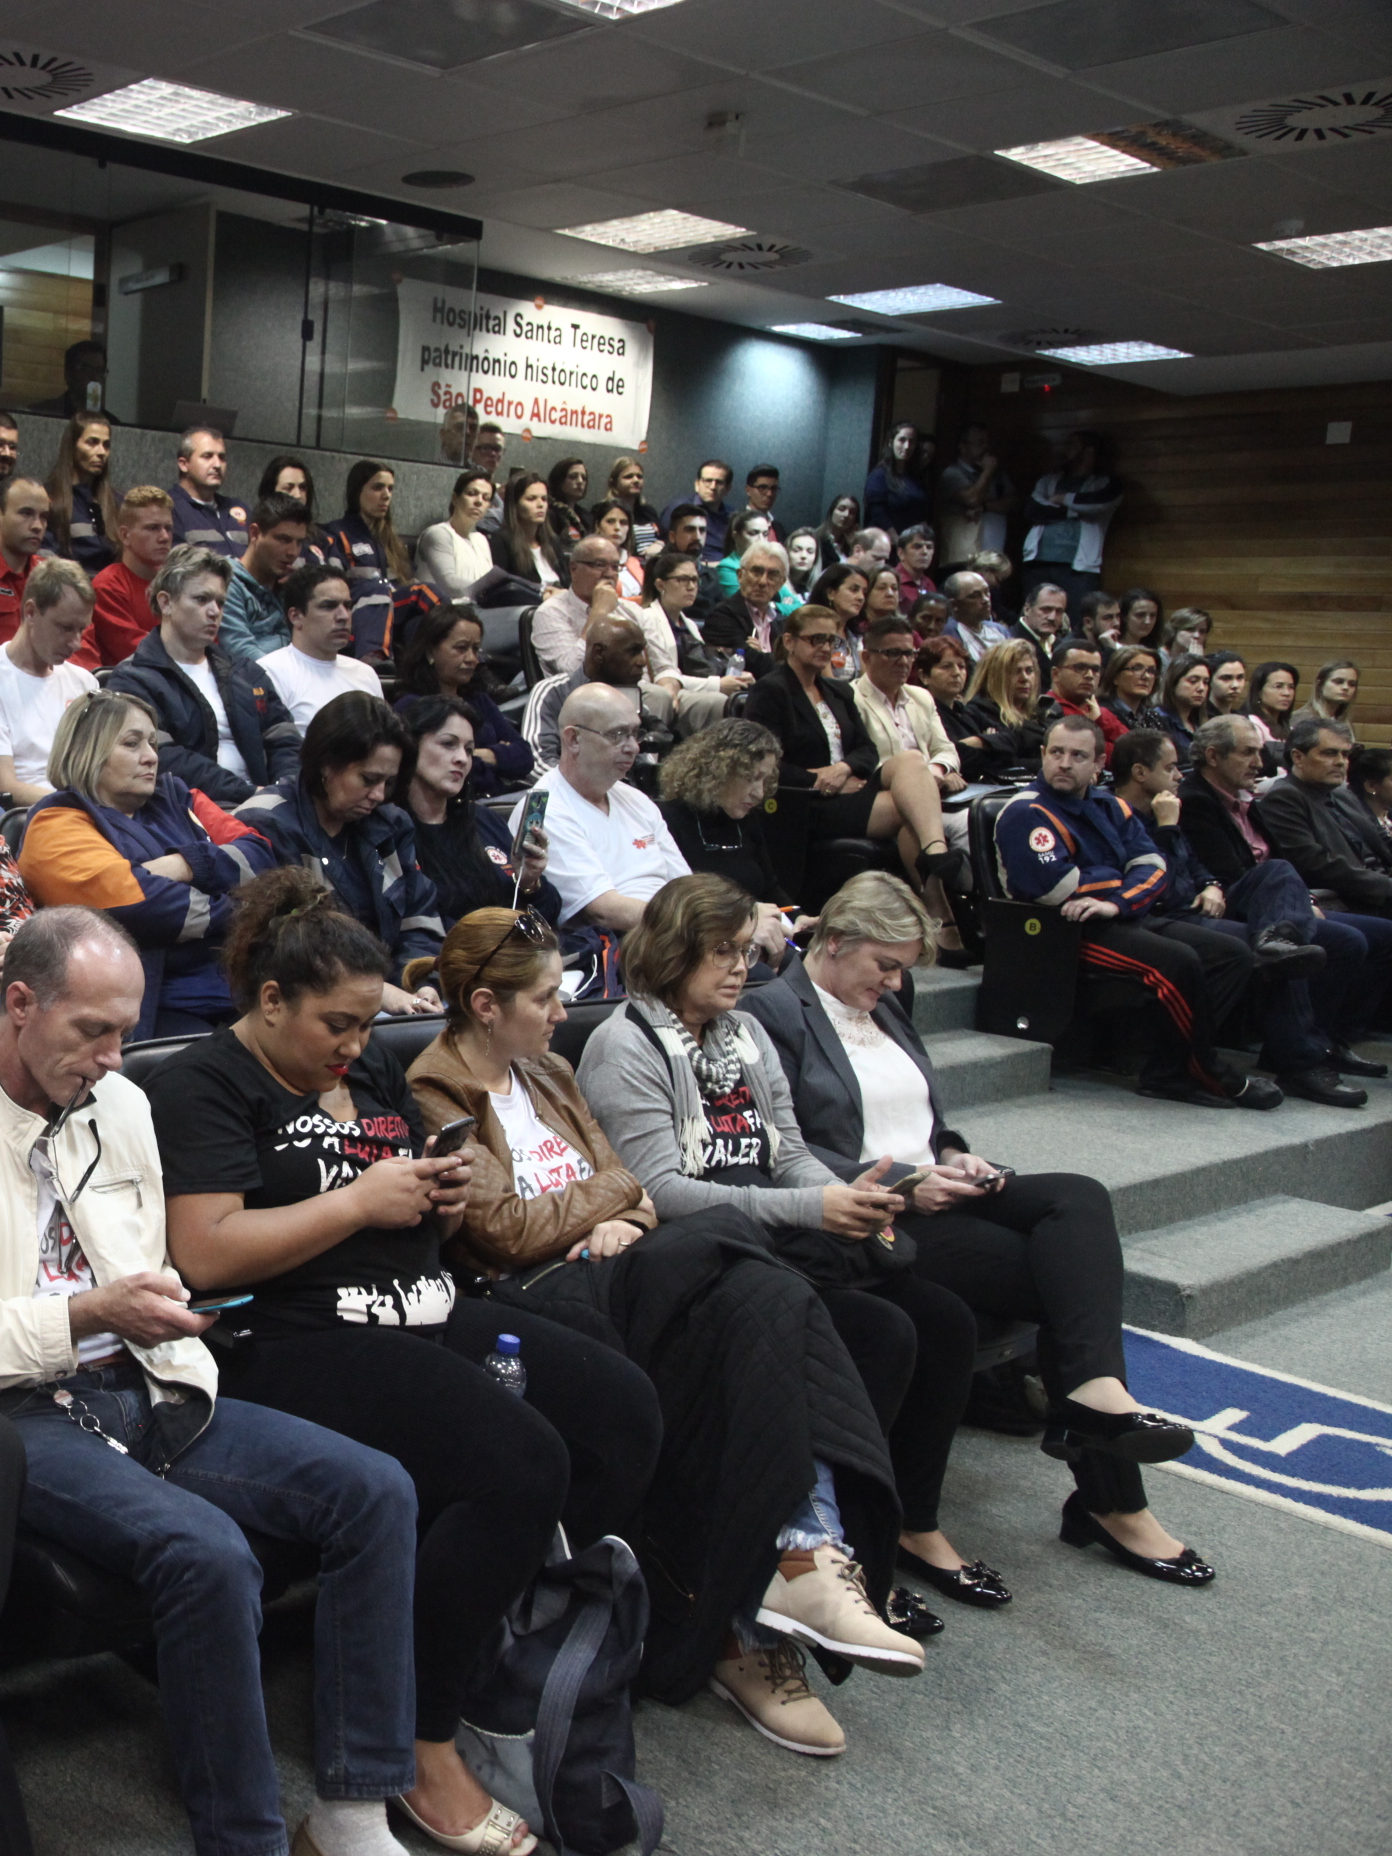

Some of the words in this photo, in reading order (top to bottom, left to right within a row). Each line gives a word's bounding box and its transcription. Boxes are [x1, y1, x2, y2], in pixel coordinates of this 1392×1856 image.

[432, 297, 507, 337] Hospital
[513, 312, 562, 345] Santa
[570, 323, 626, 357] Teresa
[420, 343, 518, 379] patrimônio
[524, 356, 598, 392] histórico
[605, 370, 625, 396] de
[430, 381, 465, 411] São
[472, 387, 524, 420] Pedro
[529, 397, 613, 432] Alcântara
[1039, 855, 1057, 864] 192
[1029, 923, 1036, 931] B
[534, 1163, 578, 1194] LUTA
